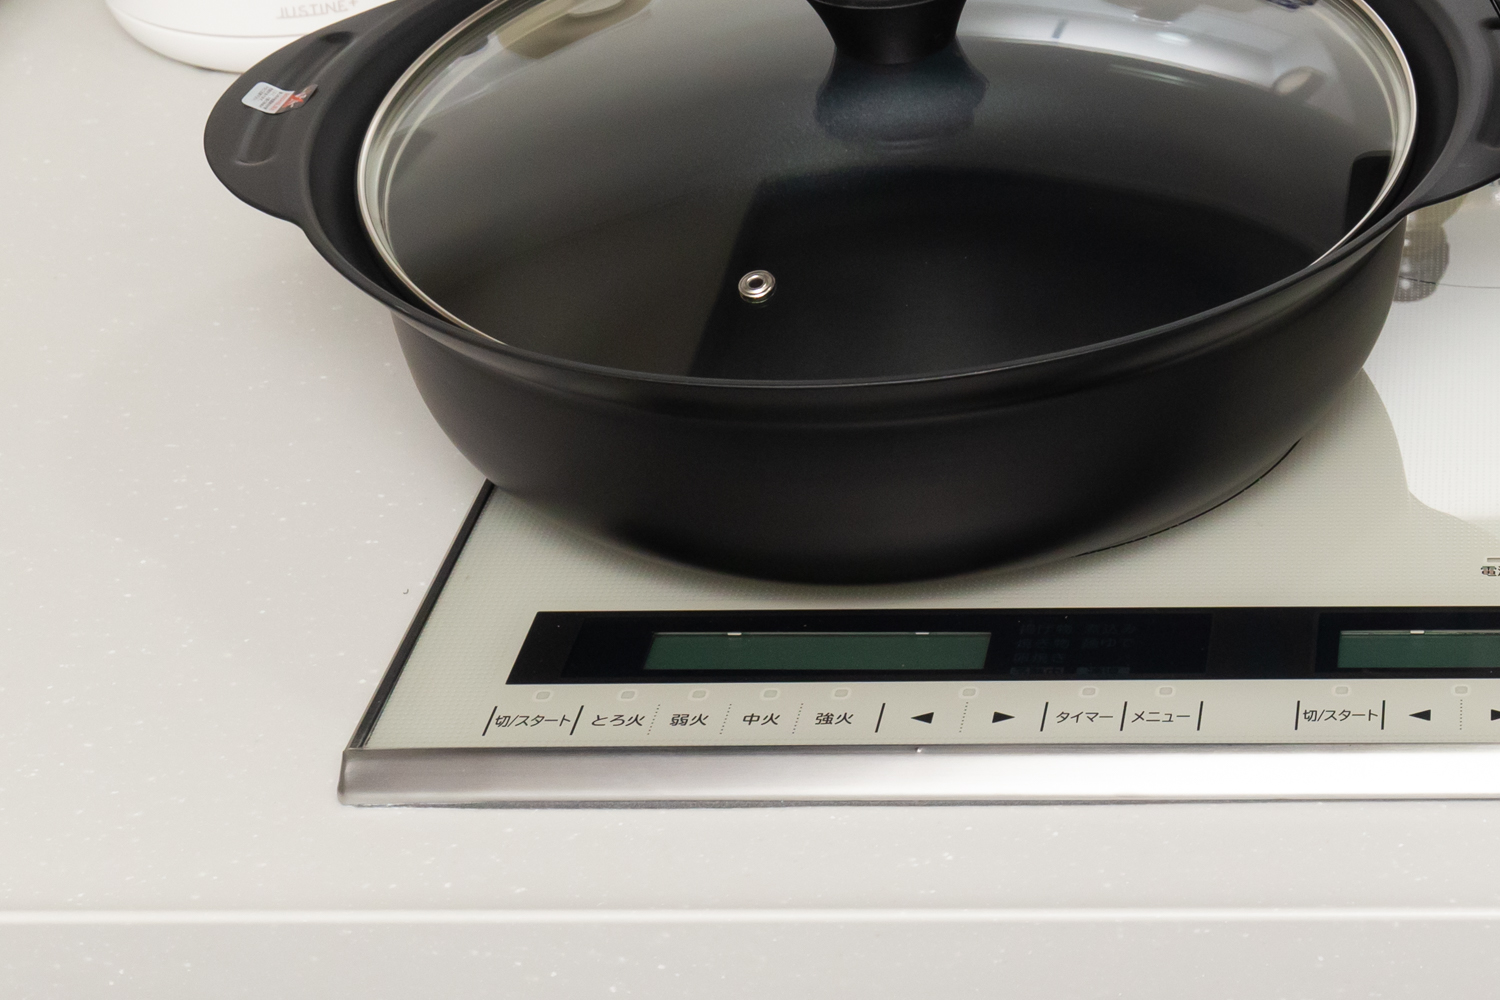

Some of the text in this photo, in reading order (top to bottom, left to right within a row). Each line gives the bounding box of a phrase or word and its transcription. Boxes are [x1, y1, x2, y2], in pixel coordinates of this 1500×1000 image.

[495, 714, 571, 728] 切/スタート
[591, 713, 646, 727] とろ火
[669, 713, 710, 727] 弱火
[742, 712, 781, 726] 中火
[814, 711, 855, 726] 強火
[1055, 710, 1114, 724] タイマー
[1131, 710, 1191, 723] メニュー
[1302, 708, 1379, 722] 切/スタート
